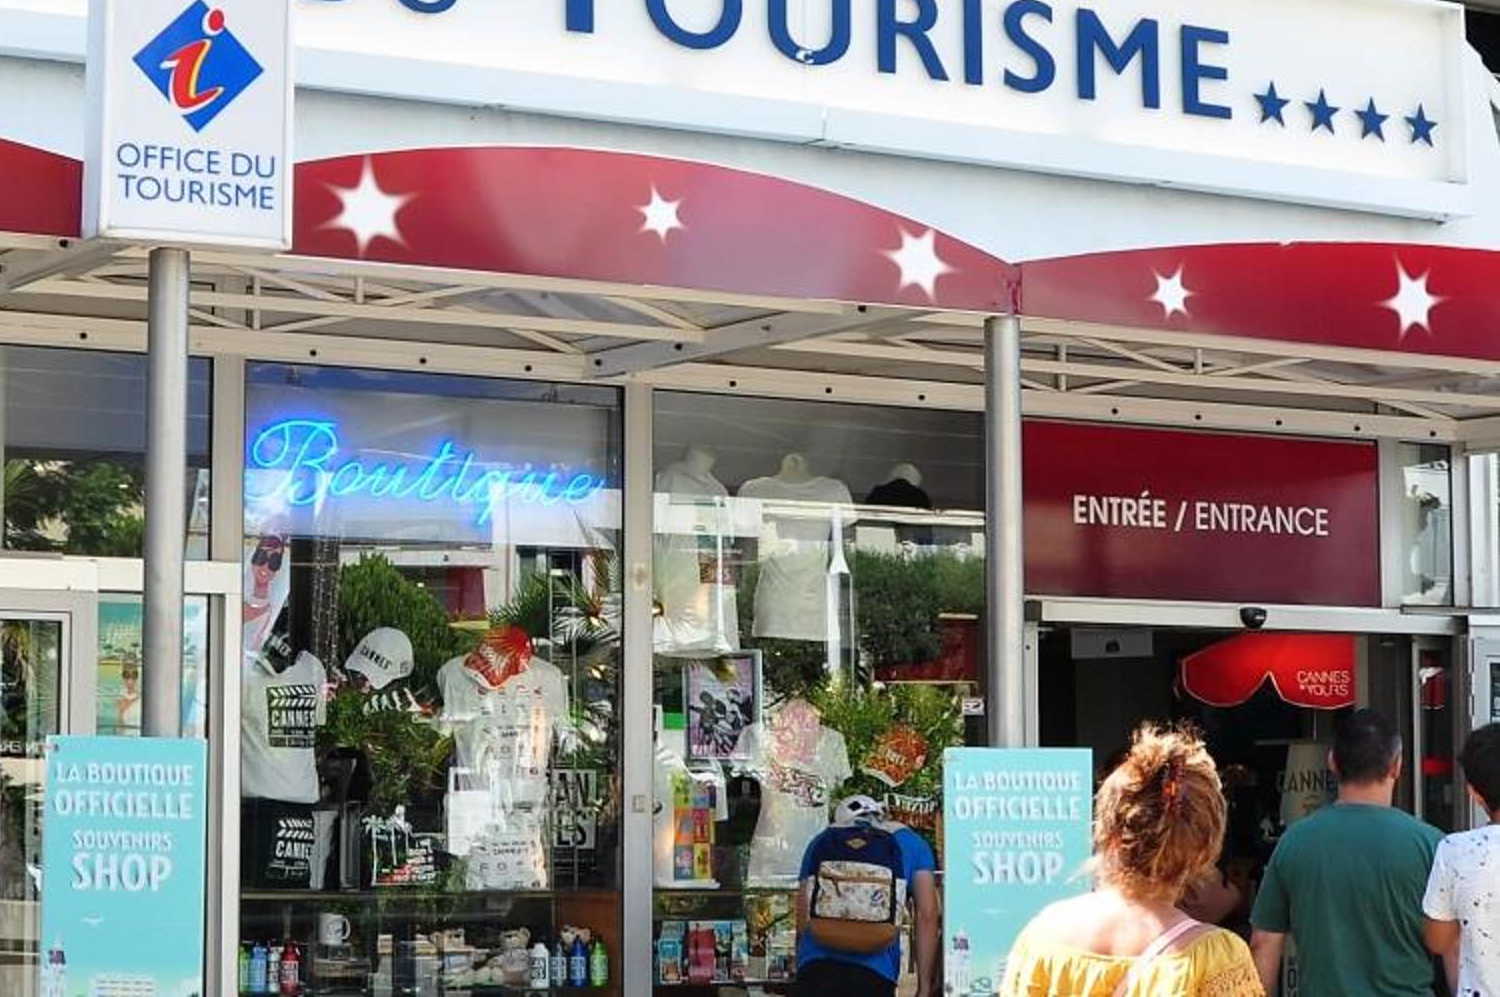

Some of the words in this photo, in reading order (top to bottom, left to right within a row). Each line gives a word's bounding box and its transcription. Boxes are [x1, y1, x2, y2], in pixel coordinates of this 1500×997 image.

[116, 142, 222, 175] OFFICE
[231, 152, 275, 179] DU
[117, 174, 275, 211] TOURISME
[1073, 490, 1167, 528] ENTRÉE
[1173, 501, 1188, 532] /
[1195, 502, 1329, 536] ENTRANCE
[271, 709, 315, 728] CANNES
[56, 762, 83, 783] LA
[87, 762, 195, 788] BOUTIQUE
[956, 772, 980, 792] LA
[984, 771, 1081, 792] BOUTIQUE
[54, 789, 195, 820] OFFICIELLE
[955, 795, 1082, 820] OFFICIELLE
[72, 829, 173, 851] SOUVENIRS
[971, 830, 1063, 849] SOUVENIRS
[72, 852, 173, 892] SHOP
[972, 851, 1064, 885] SHOP
